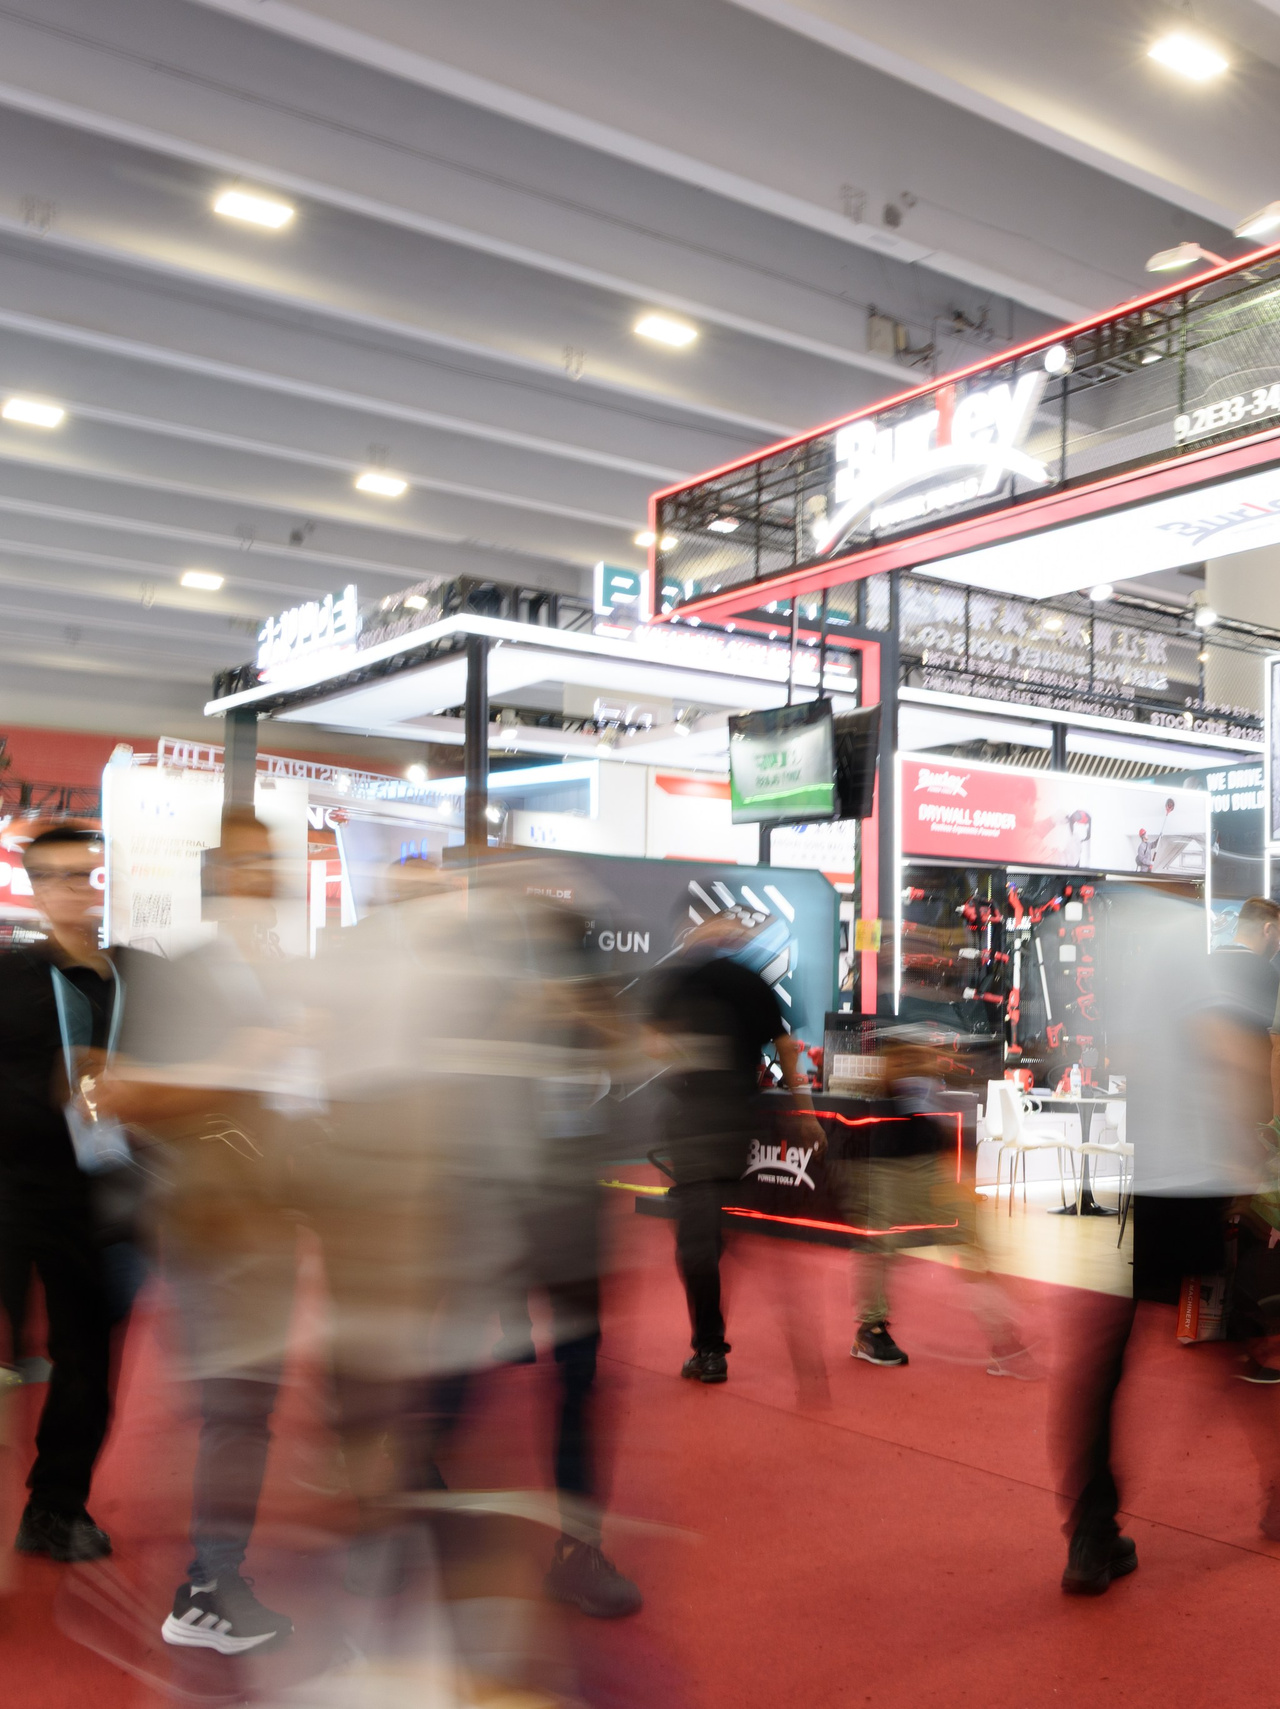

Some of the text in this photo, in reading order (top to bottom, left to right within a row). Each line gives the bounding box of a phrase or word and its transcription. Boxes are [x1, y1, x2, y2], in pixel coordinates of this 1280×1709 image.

[833, 369, 1050, 505] Burley
[1193, 719, 1228, 736] CODE
[1206, 772, 1227, 791] WE
[918, 803, 972, 826] DRYWALL
[972, 809, 1017, 831] SANDER
[526, 887, 572, 899] PRULDE
[598, 930, 650, 955] GUN
[742, 1138, 814, 1189] Burley
[757, 1173, 794, 1187] POWER TOOLS
[1184, 1285, 1195, 1329] MACHINERY
